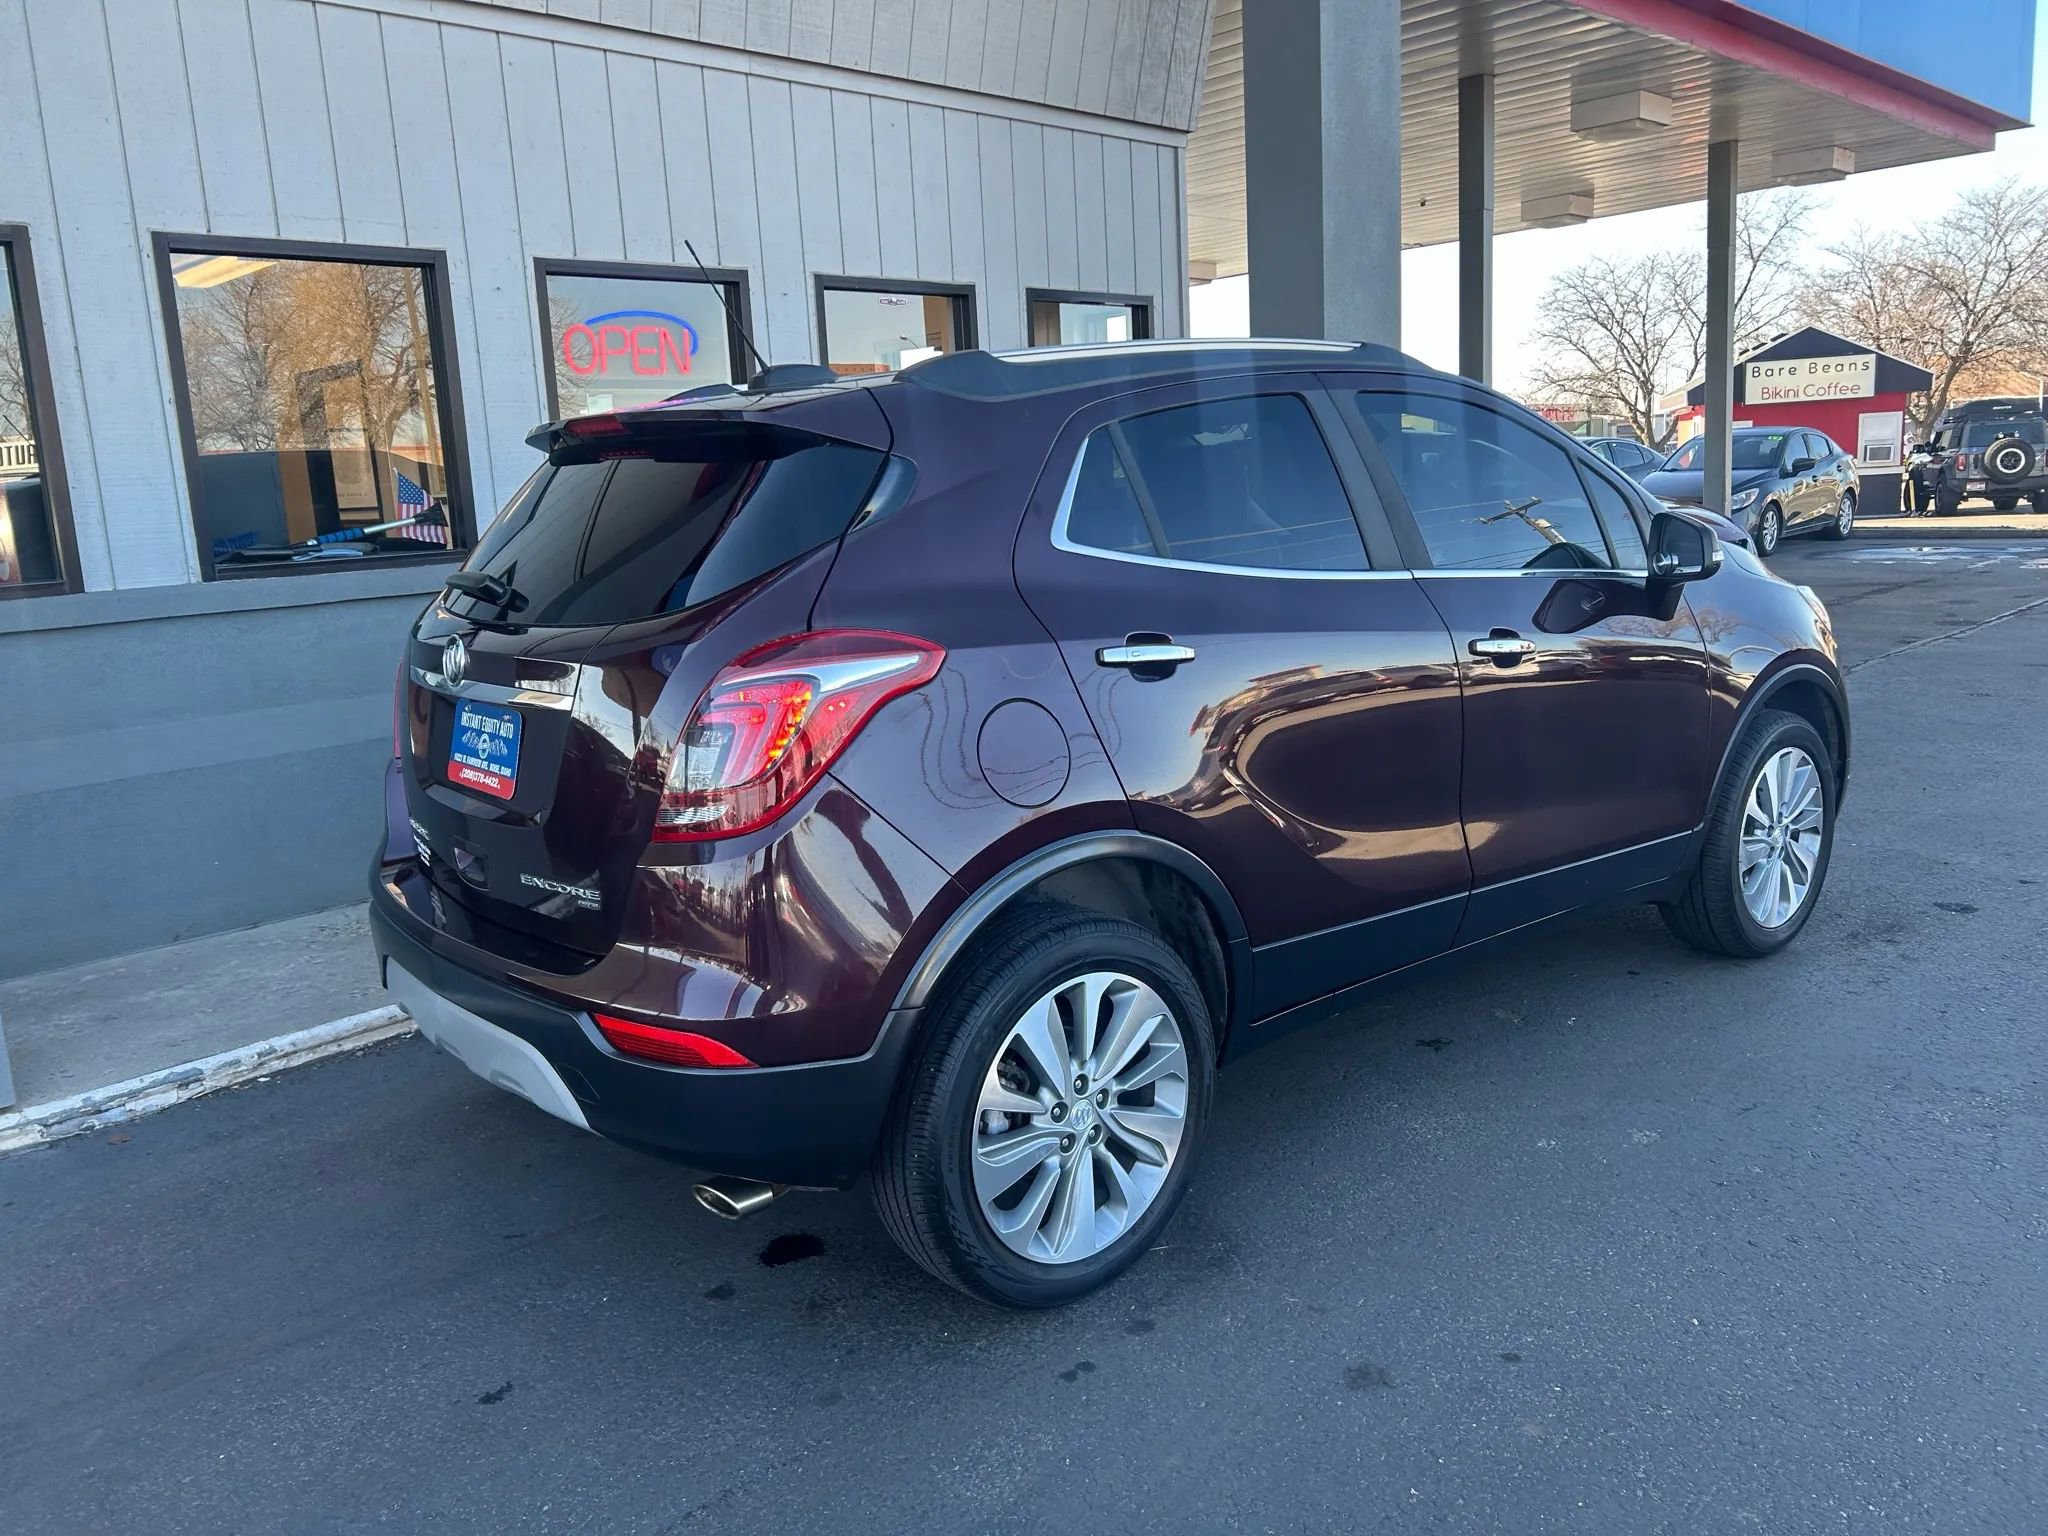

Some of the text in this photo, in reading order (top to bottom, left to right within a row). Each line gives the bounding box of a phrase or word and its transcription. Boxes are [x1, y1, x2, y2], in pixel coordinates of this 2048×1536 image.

[562, 323, 692, 374] OPEN
[1752, 361, 1870, 378] Bare Beans
[1761, 382, 1861, 400] Bikini Coffee
[461, 711, 514, 739] INSTANT EQUITY AUTO
[520, 873, 601, 900] ENCORE
